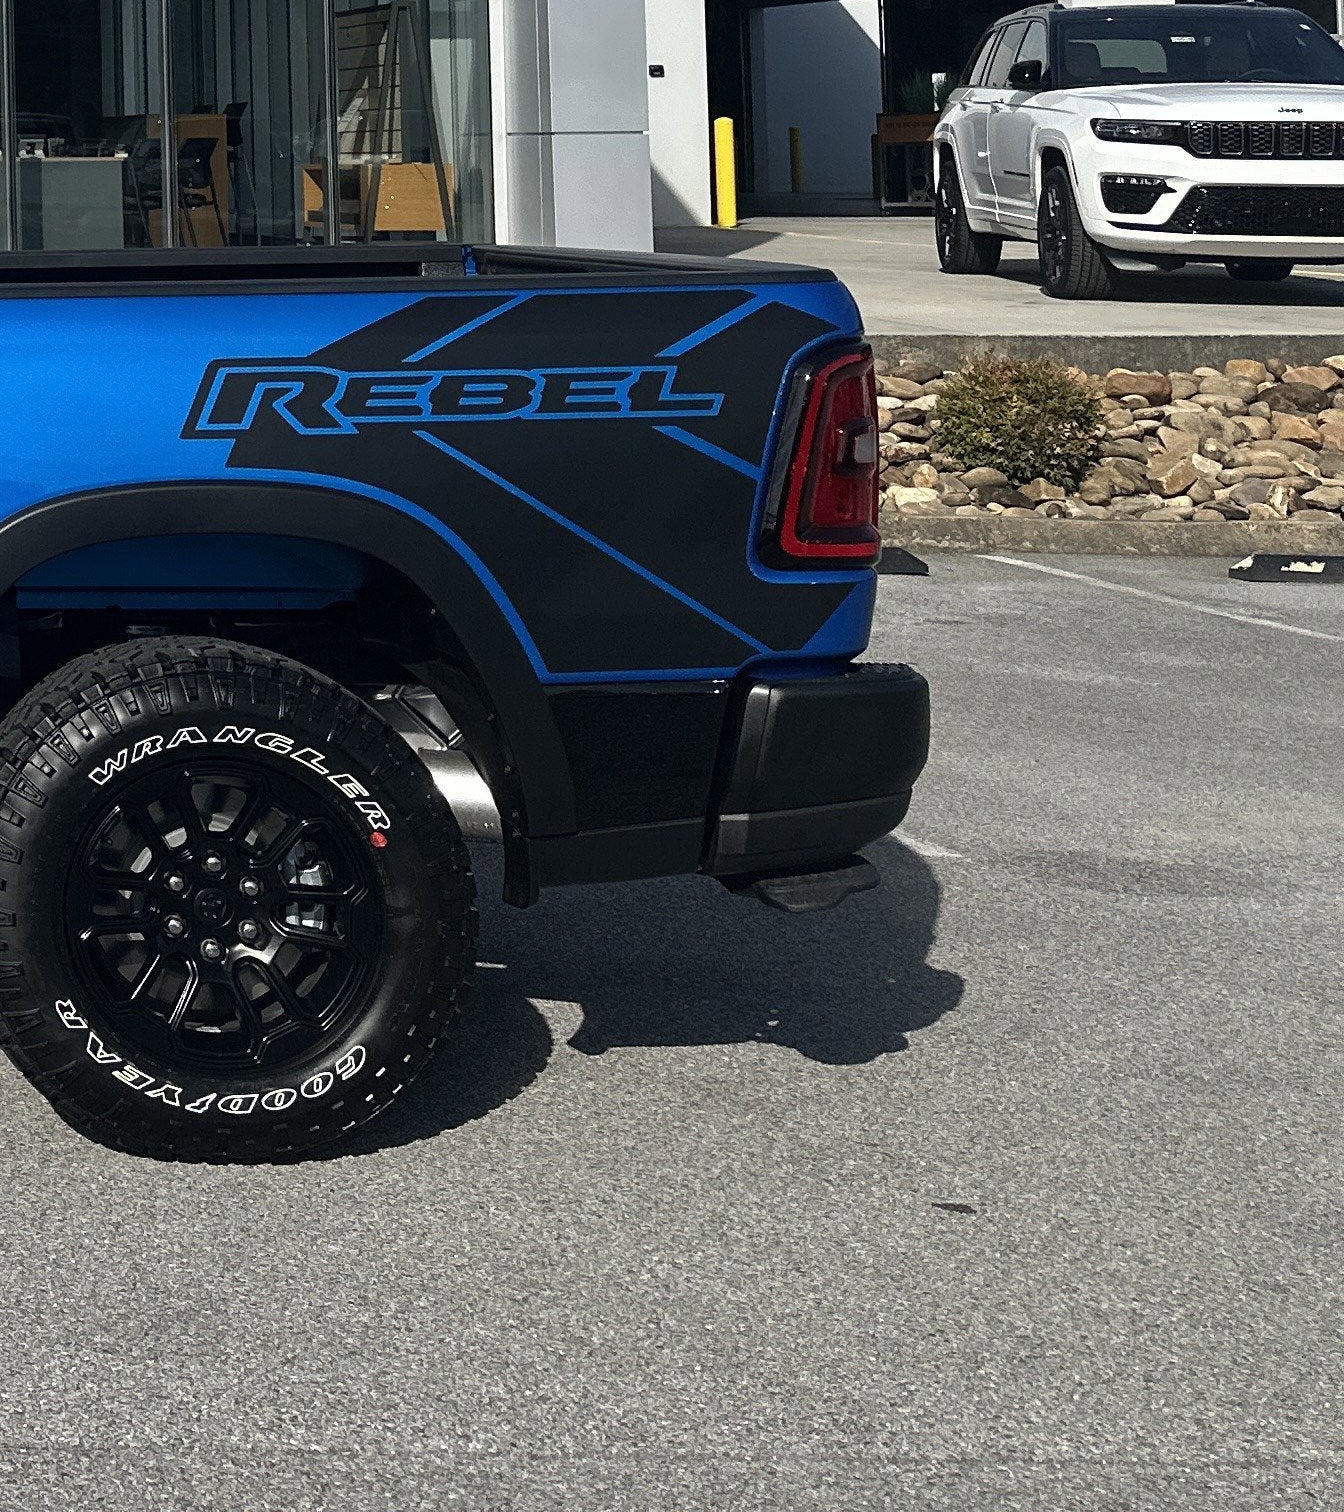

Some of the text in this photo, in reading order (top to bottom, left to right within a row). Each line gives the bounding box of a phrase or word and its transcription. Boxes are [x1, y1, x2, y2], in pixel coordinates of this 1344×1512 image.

[195, 364, 724, 435] REBEL
[88, 725, 391, 832] WRANGLER
[54, 998, 368, 1115] GOODYEAR
